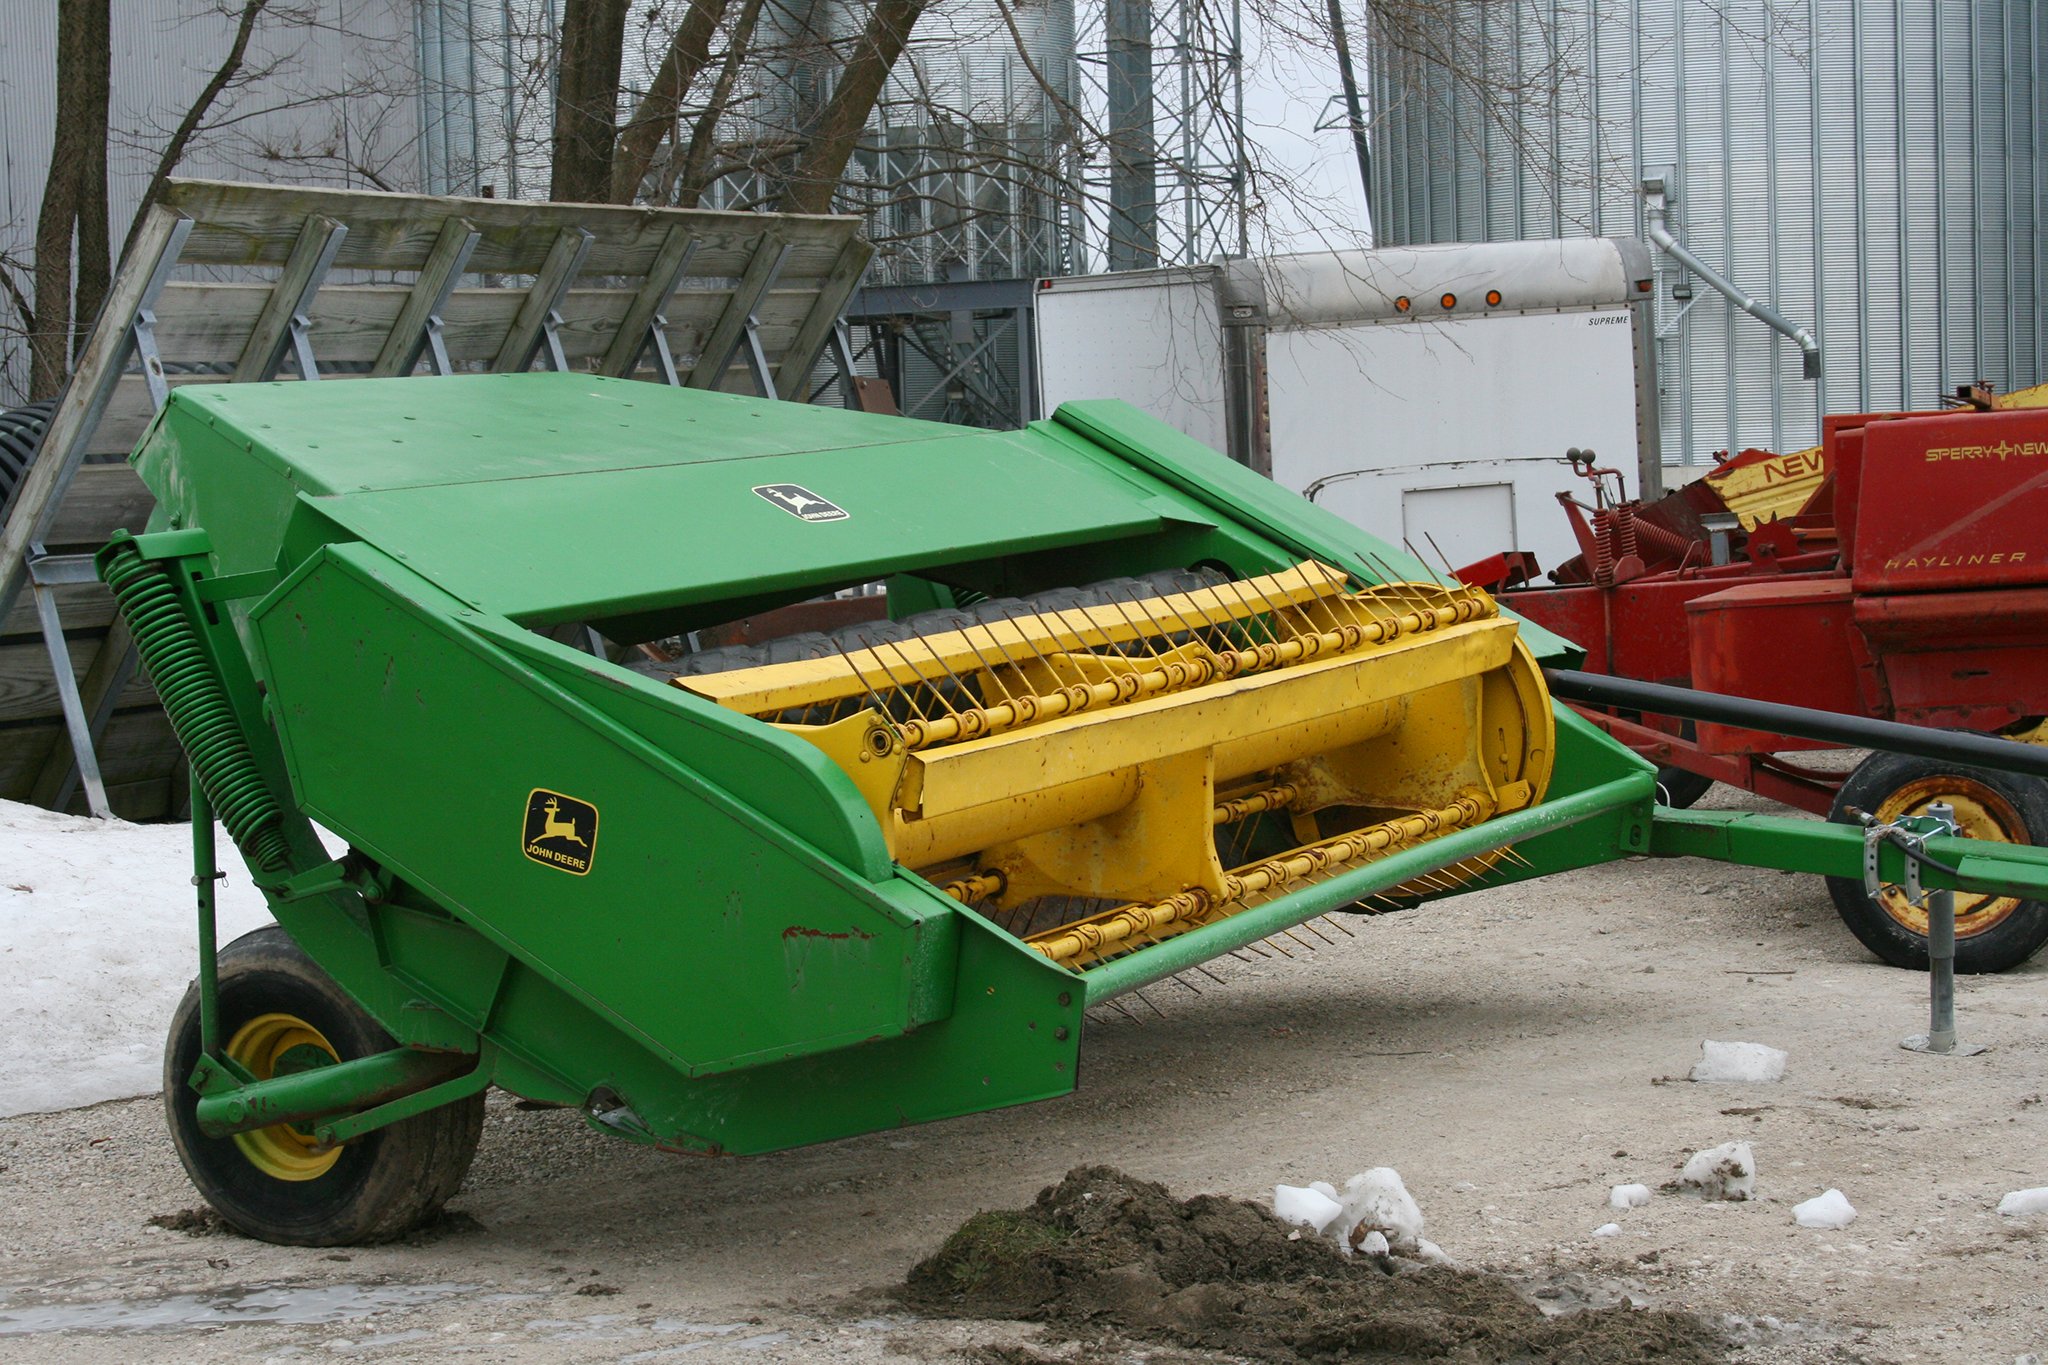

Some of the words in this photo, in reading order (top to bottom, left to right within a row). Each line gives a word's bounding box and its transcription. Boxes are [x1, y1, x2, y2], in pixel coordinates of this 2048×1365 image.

[1588, 315, 1629, 326] SUPREME
[1925, 446, 1993, 462] SPERRY
[2014, 442, 2048, 456] NEW
[1885, 552, 2026, 569] HAYLINER
[526, 844, 553, 860] JOHN
[554, 853, 586, 870] DEERE
